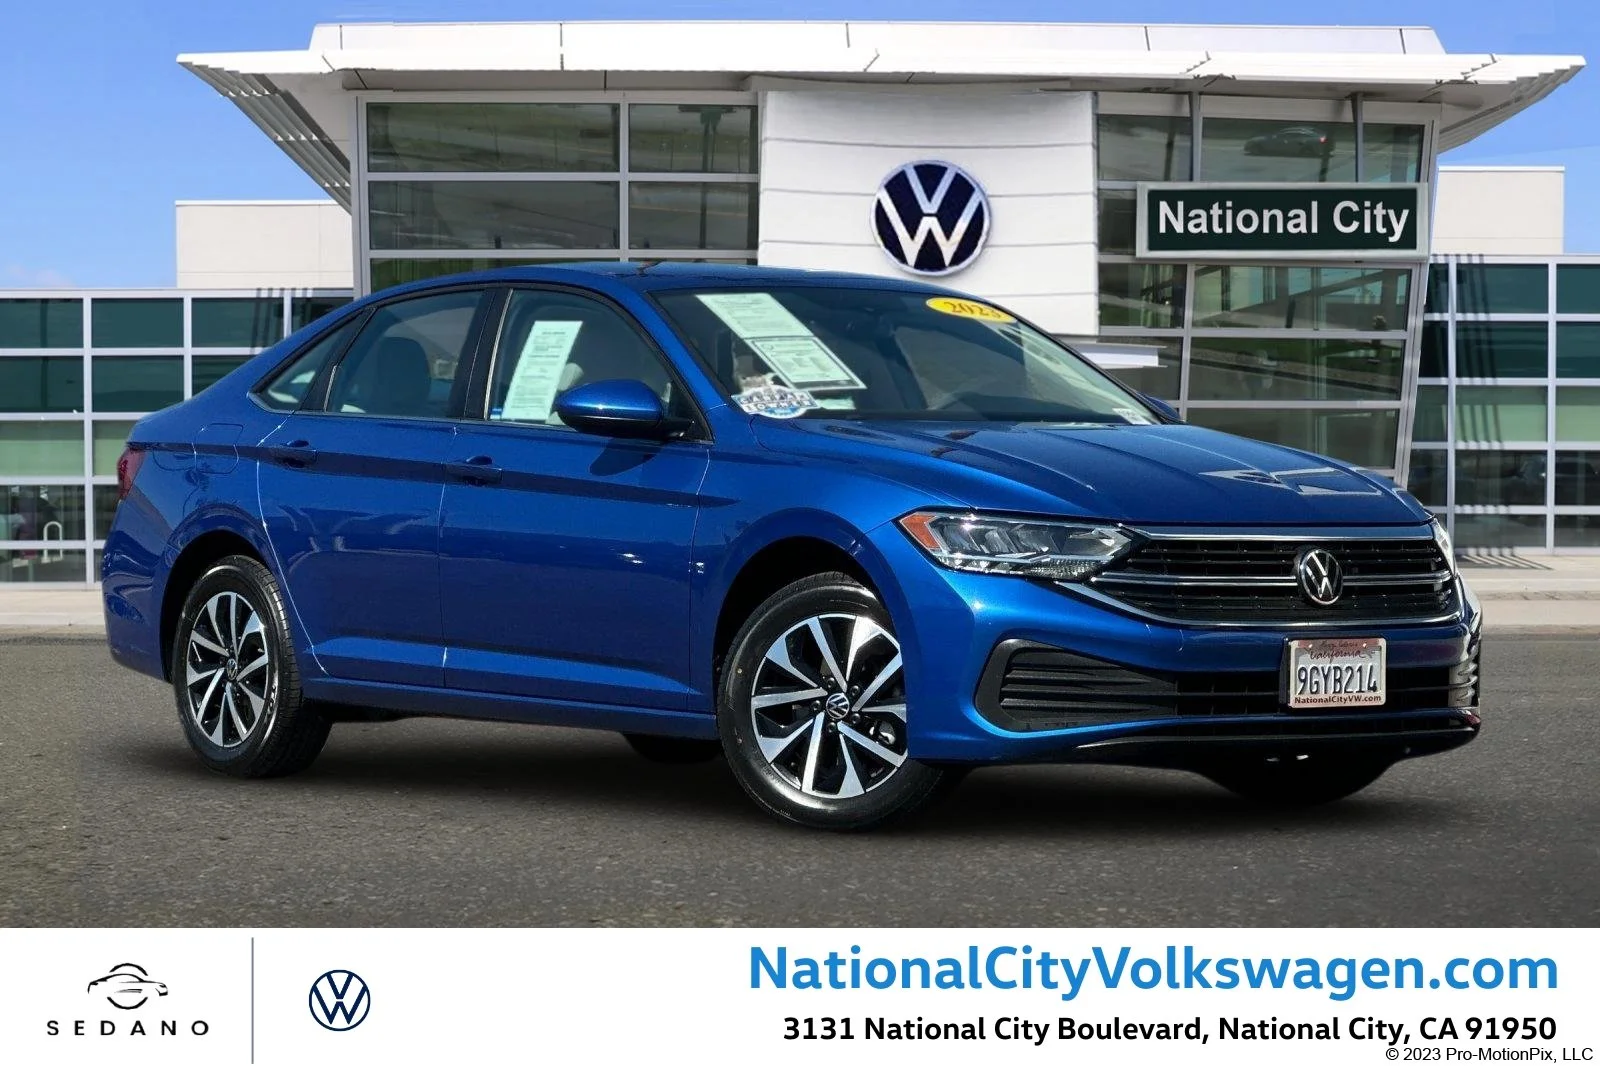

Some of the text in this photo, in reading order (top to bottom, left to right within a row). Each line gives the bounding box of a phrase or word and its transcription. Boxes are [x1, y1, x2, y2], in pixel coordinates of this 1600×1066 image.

[1158, 200, 1410, 243] National City
[1297, 664, 1378, 694] 9GYB214
[1294, 695, 1382, 704] NationalCityVW.com
